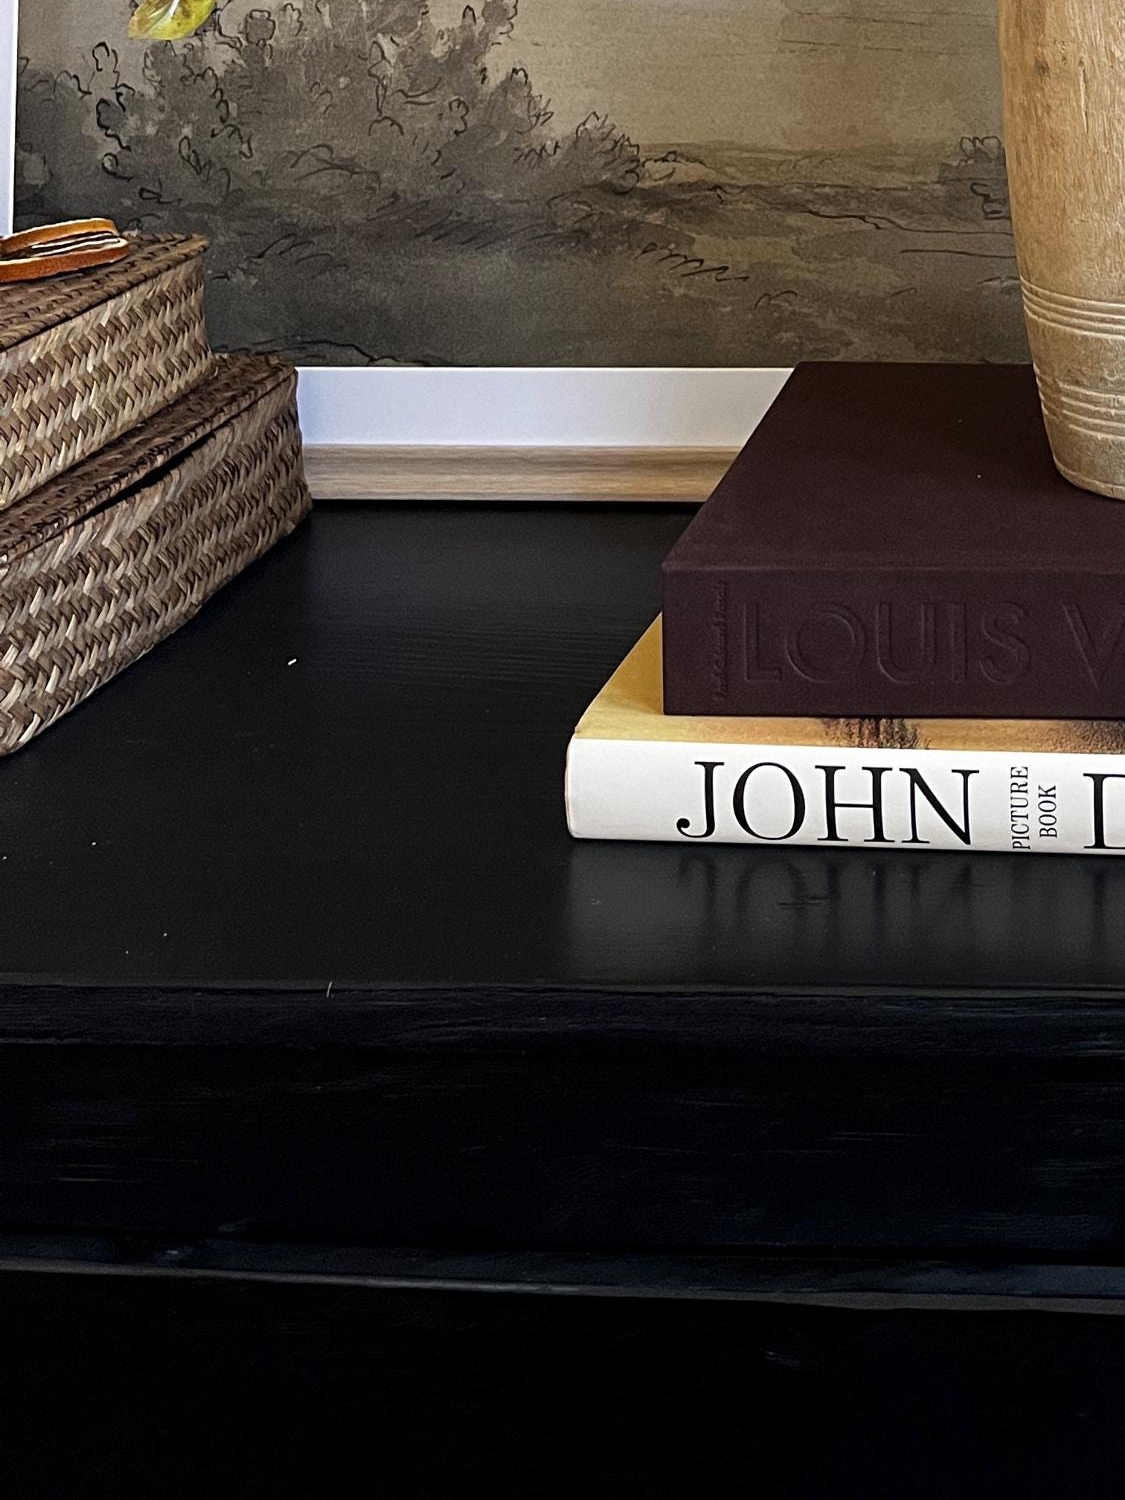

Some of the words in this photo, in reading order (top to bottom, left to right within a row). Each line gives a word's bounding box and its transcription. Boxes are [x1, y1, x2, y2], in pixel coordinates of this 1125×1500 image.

[742, 599, 1032, 686] LOUIS
[676, 761, 980, 846] JOHN
[1010, 766, 1031, 850] PICTURE
[1038, 784, 1058, 839] BOOK
